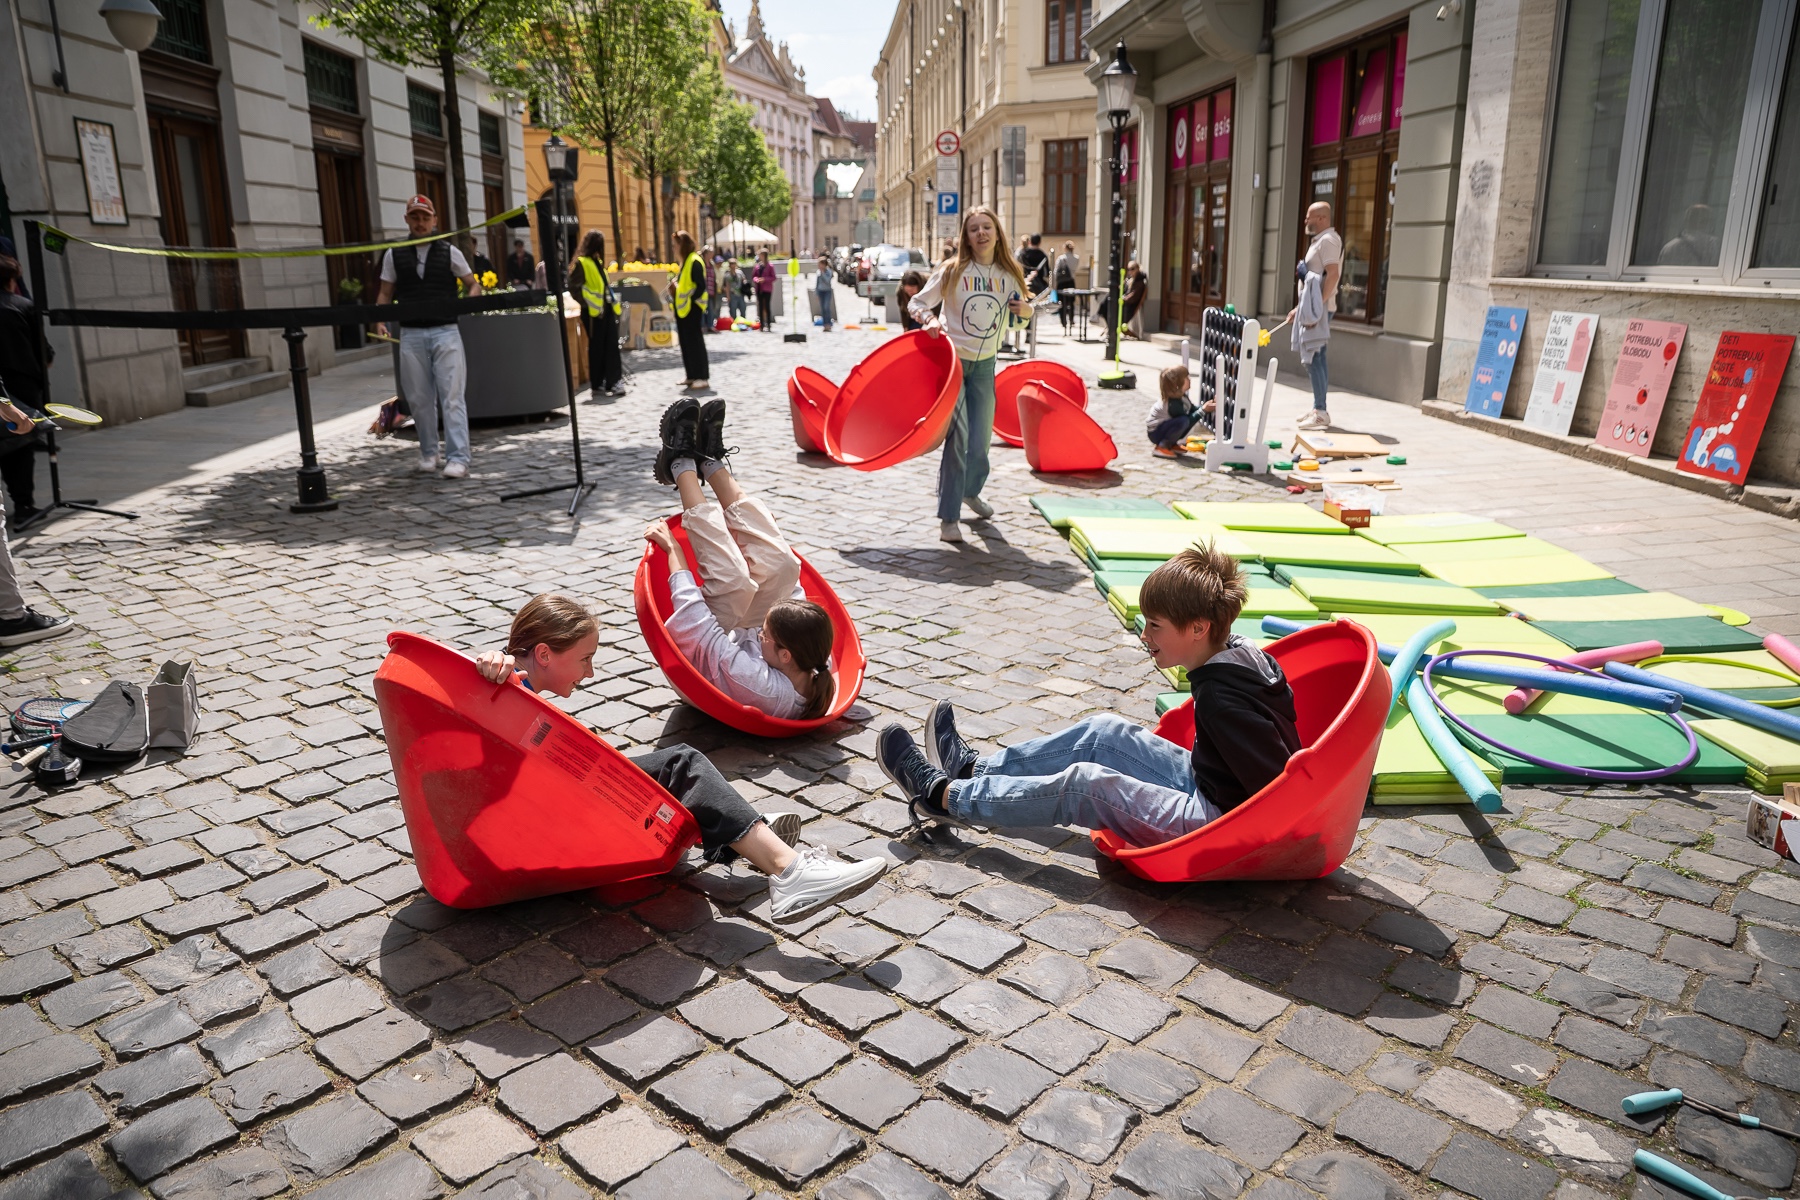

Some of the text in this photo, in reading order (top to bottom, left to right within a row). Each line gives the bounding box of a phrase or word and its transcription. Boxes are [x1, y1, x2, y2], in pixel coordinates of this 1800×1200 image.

[942, 195, 954, 212] P
[963, 276, 1005, 293] NIRVANA
[1552, 314, 1573, 326] AJ PRE
[1550, 325, 1561, 336] VÁS
[1630, 322, 1643, 331] DETI
[1547, 336, 1568, 347] VZNIKÁ
[1627, 334, 1662, 347] POTREBUJÚ
[1722, 335, 1740, 345] DETI
[1544, 347, 1565, 359] MESTO
[1622, 345, 1651, 359] SLOBODU
[1718, 348, 1764, 361] POTREBUJÚ
[1541, 358, 1552, 368] PRE
[1714, 361, 1735, 373] ČISTÉ
